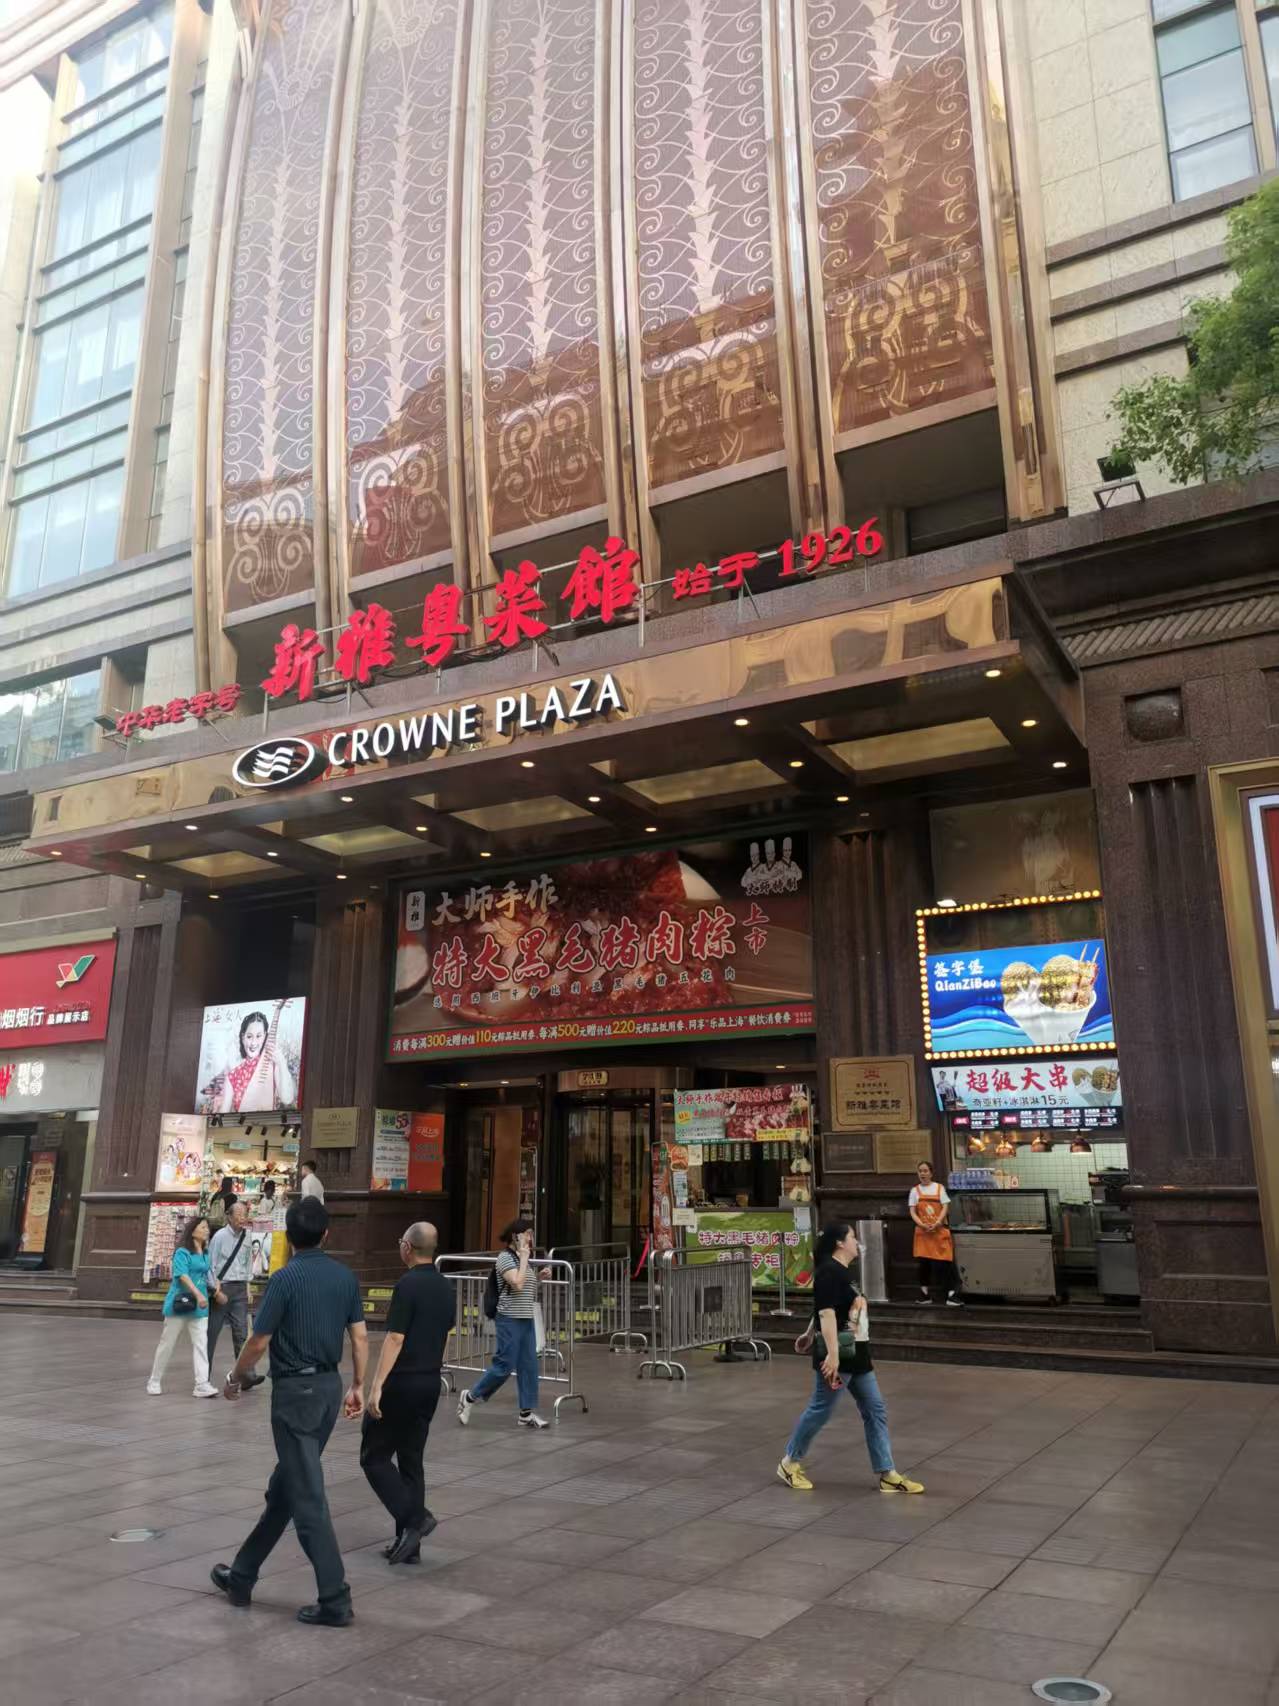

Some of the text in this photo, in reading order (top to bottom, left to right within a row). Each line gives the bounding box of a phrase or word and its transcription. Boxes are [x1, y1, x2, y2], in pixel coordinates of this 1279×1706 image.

[671, 516, 886, 599] 始于 1926
[327, 672, 621, 766] CROWNE PLAZA
[431, 874, 560, 926] 大师手作
[431, 904, 737, 989] 特大黑毛猪肉粽
[741, 902, 770, 956] 上市
[0, 1006, 45, 1031] 烟烟行
[966, 1063, 1069, 1094] 超级大串
